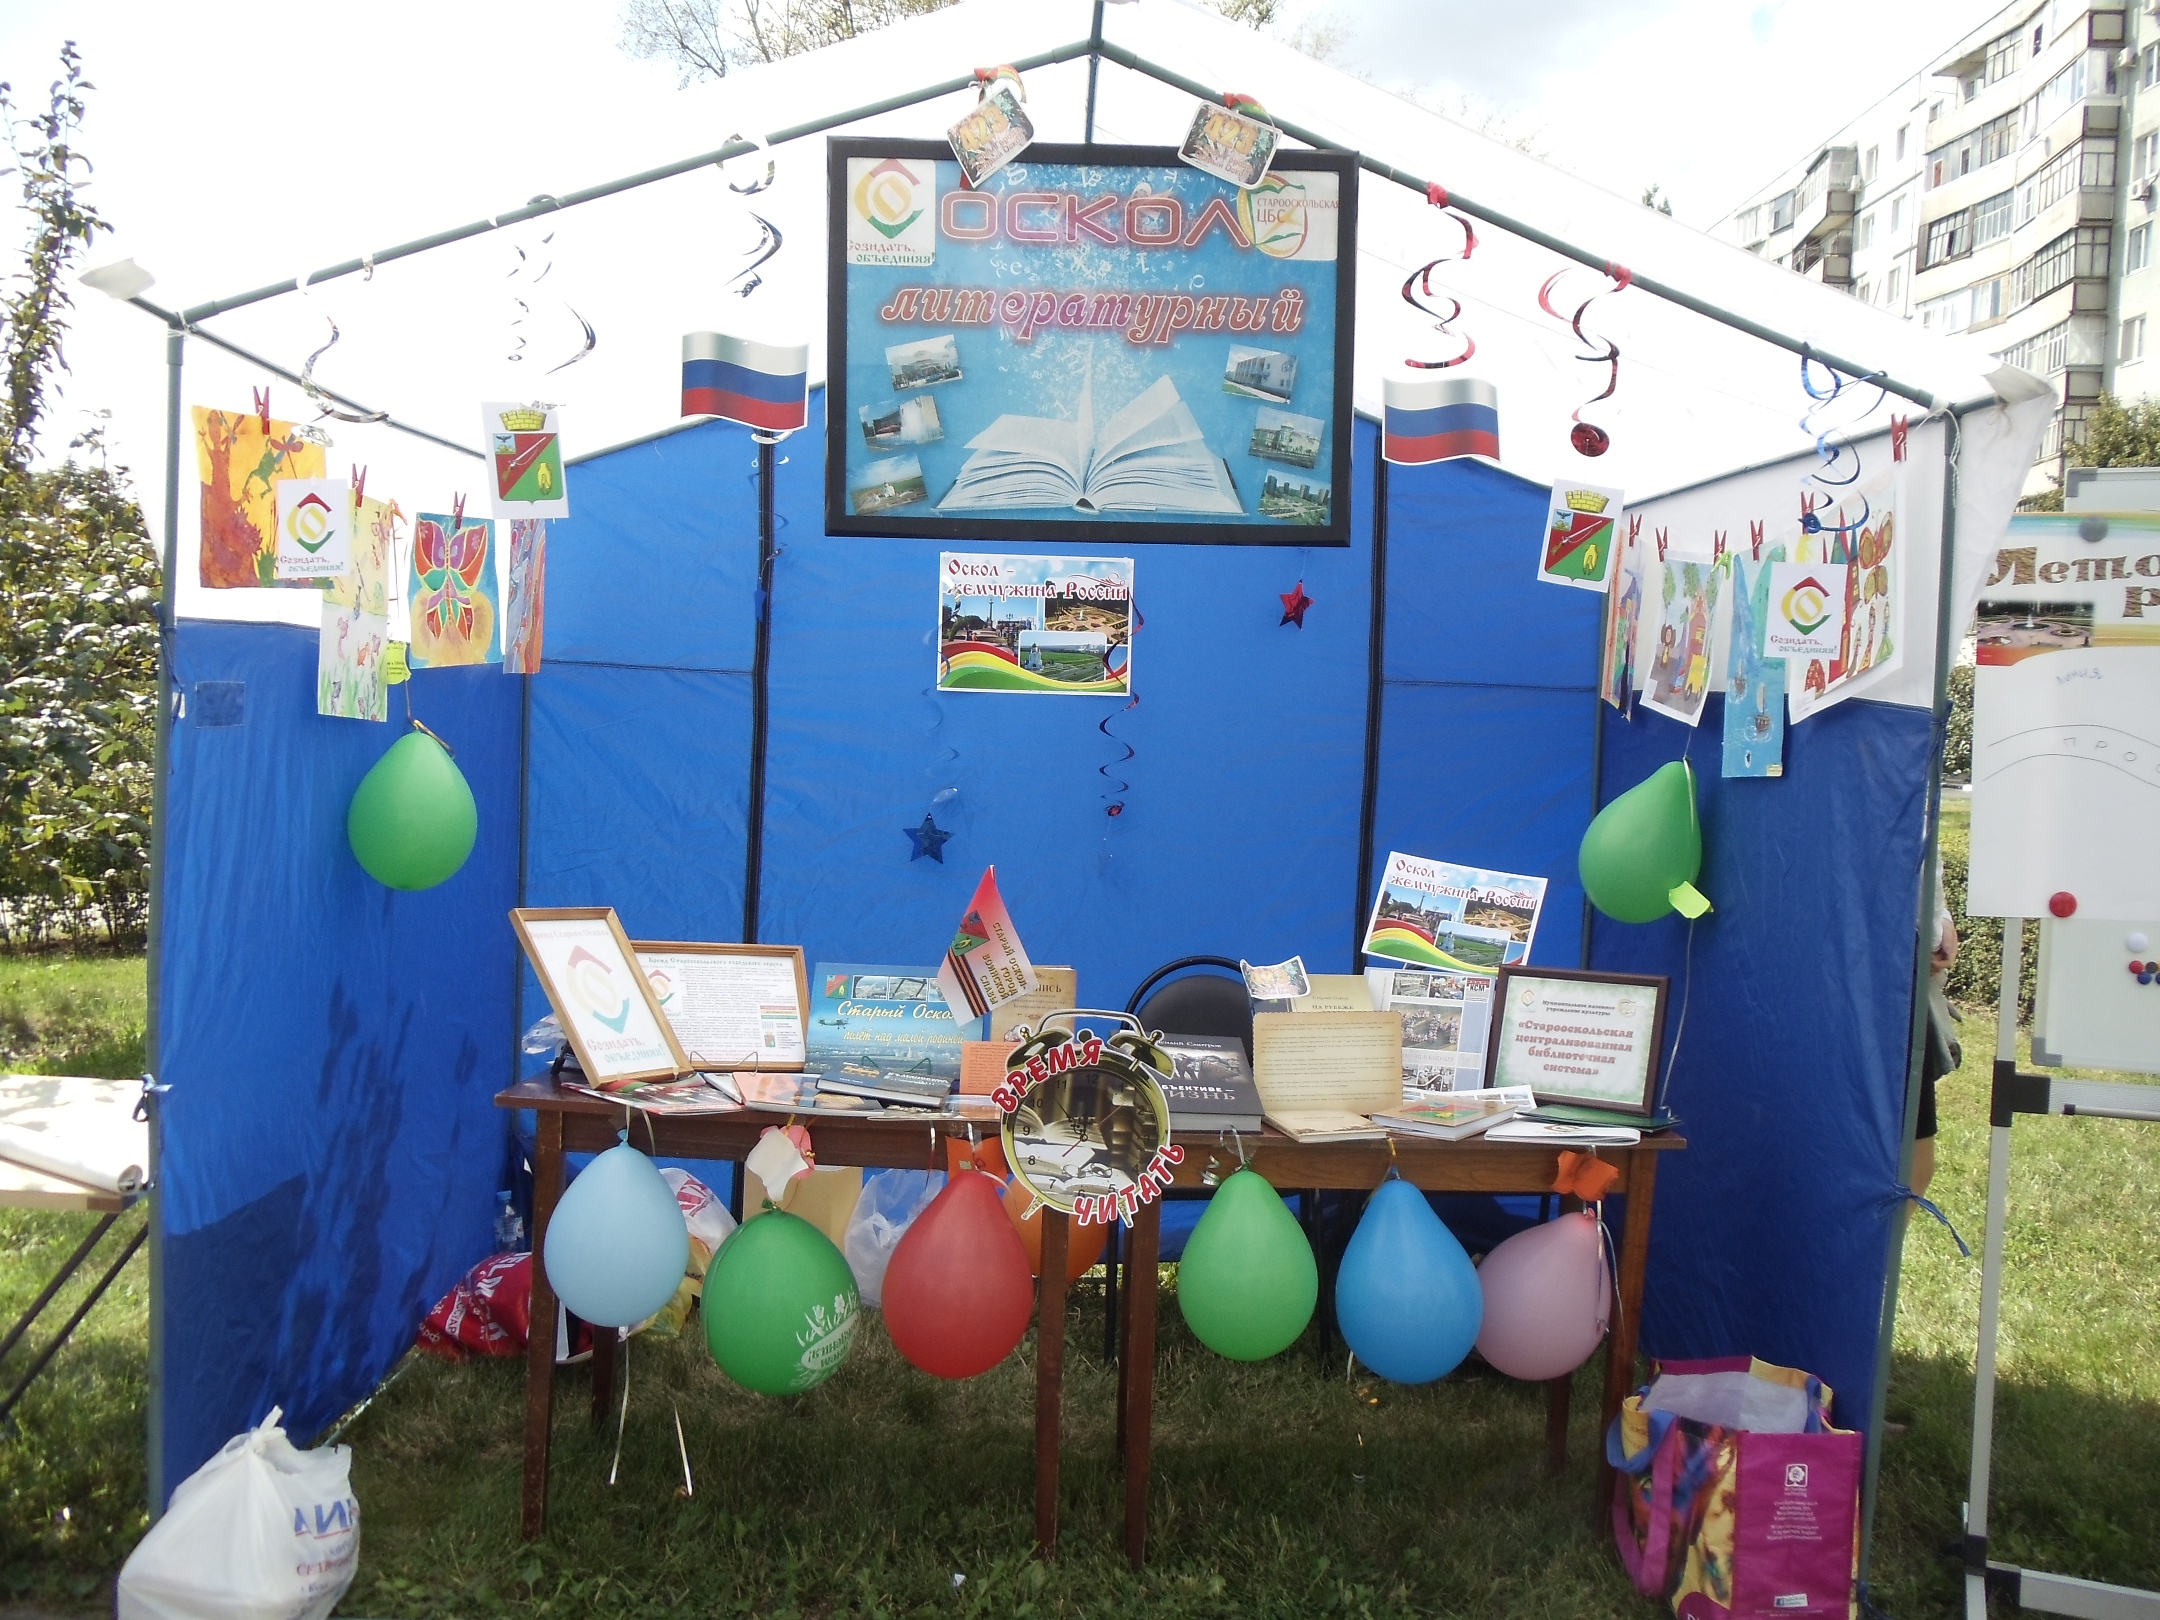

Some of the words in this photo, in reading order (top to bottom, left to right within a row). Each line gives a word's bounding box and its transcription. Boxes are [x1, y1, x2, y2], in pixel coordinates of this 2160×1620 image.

[960, 105, 1009, 151] 423
[1204, 115, 1257, 154] 423
[1257, 198, 1339, 209] СТАРООСКОЛЬСКАЯ
[941, 190, 1250, 248] ОСКОЛ
[1257, 209, 1287, 225] ЦБС
[881, 288, 1303, 344] литературный
[948, 559, 999, 577] Оскол
[1064, 581, 1129, 600] России
[1396, 859, 1436, 879] Оскол
[1390, 876, 1479, 901] жемчужина
[1483, 889, 1537, 909] России
[992, 922, 1015, 956] СТАРЫЙ
[982, 954, 1009, 1000] ВОИНСКОЙ
[1001, 966, 1018, 996] ГОРОД
[980, 975, 998, 1005] СЛАВЫ
[1469, 984, 1485, 992] КСМ
[837, 1001, 905, 1021] Старый
[912, 1004, 955, 1020] Оско
[1515, 1034, 1633, 1052] централизованная
[1528, 1046, 1616, 1064] библиотечная
[991, 1040, 1103, 1113] ВРЕМЯ
[1543, 1062, 1599, 1076] система»
[1056, 1079, 1067, 1092] 11
[1161, 1085, 1222, 1093] БЪЕКТИВЕ
[1031, 1099, 1042, 1108] 10
[1168, 1091, 1236, 1100] ИЗНЬ
[1023, 1126, 1030, 1136] 9
[1028, 1156, 1036, 1166] 8
[1049, 1178, 1056, 1189] 7
[1074, 1146, 1185, 1225] ЧИТАТЬ
